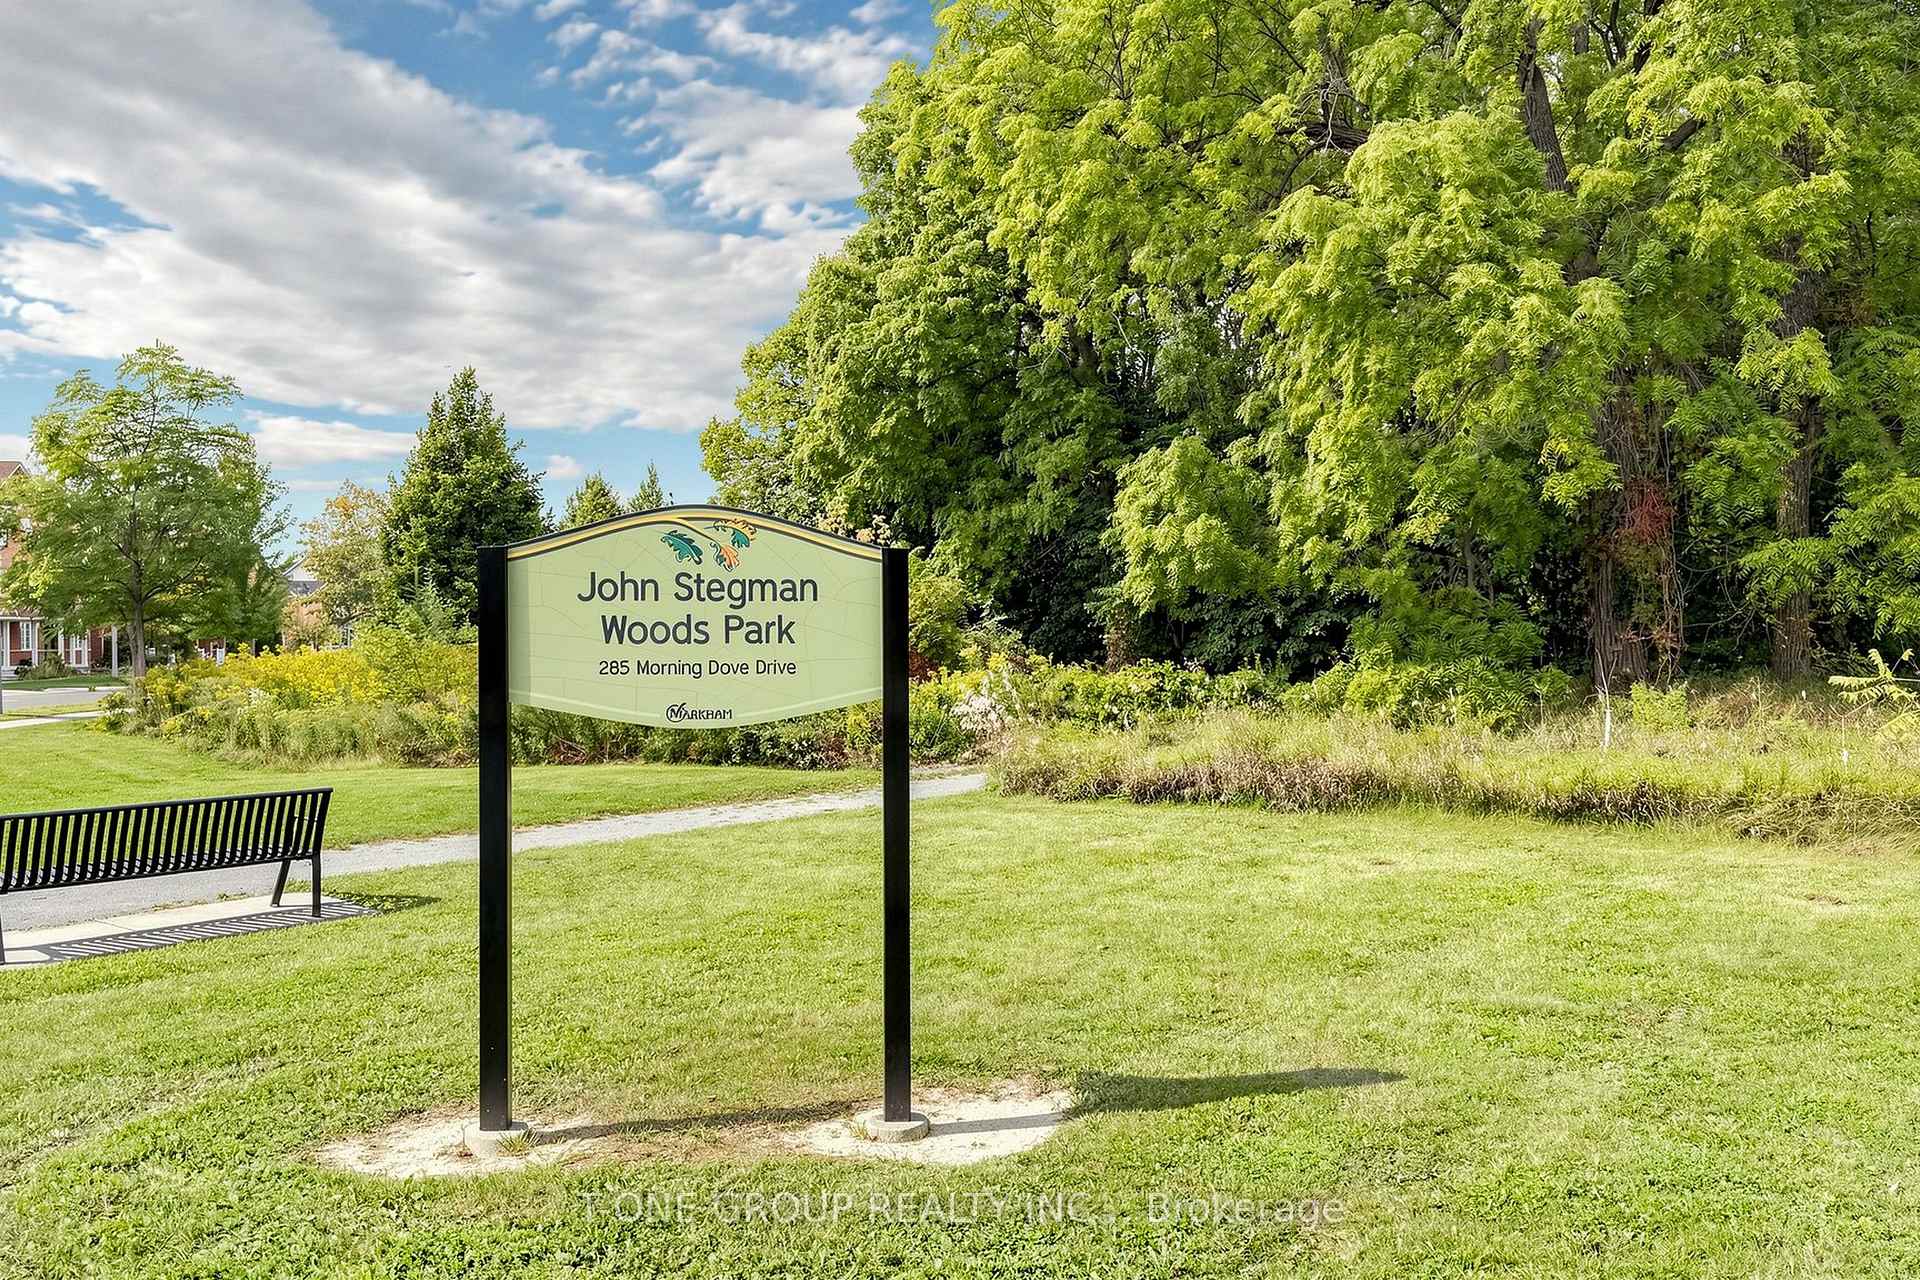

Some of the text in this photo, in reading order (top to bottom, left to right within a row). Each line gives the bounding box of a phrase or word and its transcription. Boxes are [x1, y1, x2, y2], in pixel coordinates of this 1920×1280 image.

[577, 571, 818, 610] John Stegman
[601, 614, 796, 645] Woods Park
[599, 660, 797, 680] 285 Morning Dove Drive
[666, 702, 732, 723] MARKHAM
